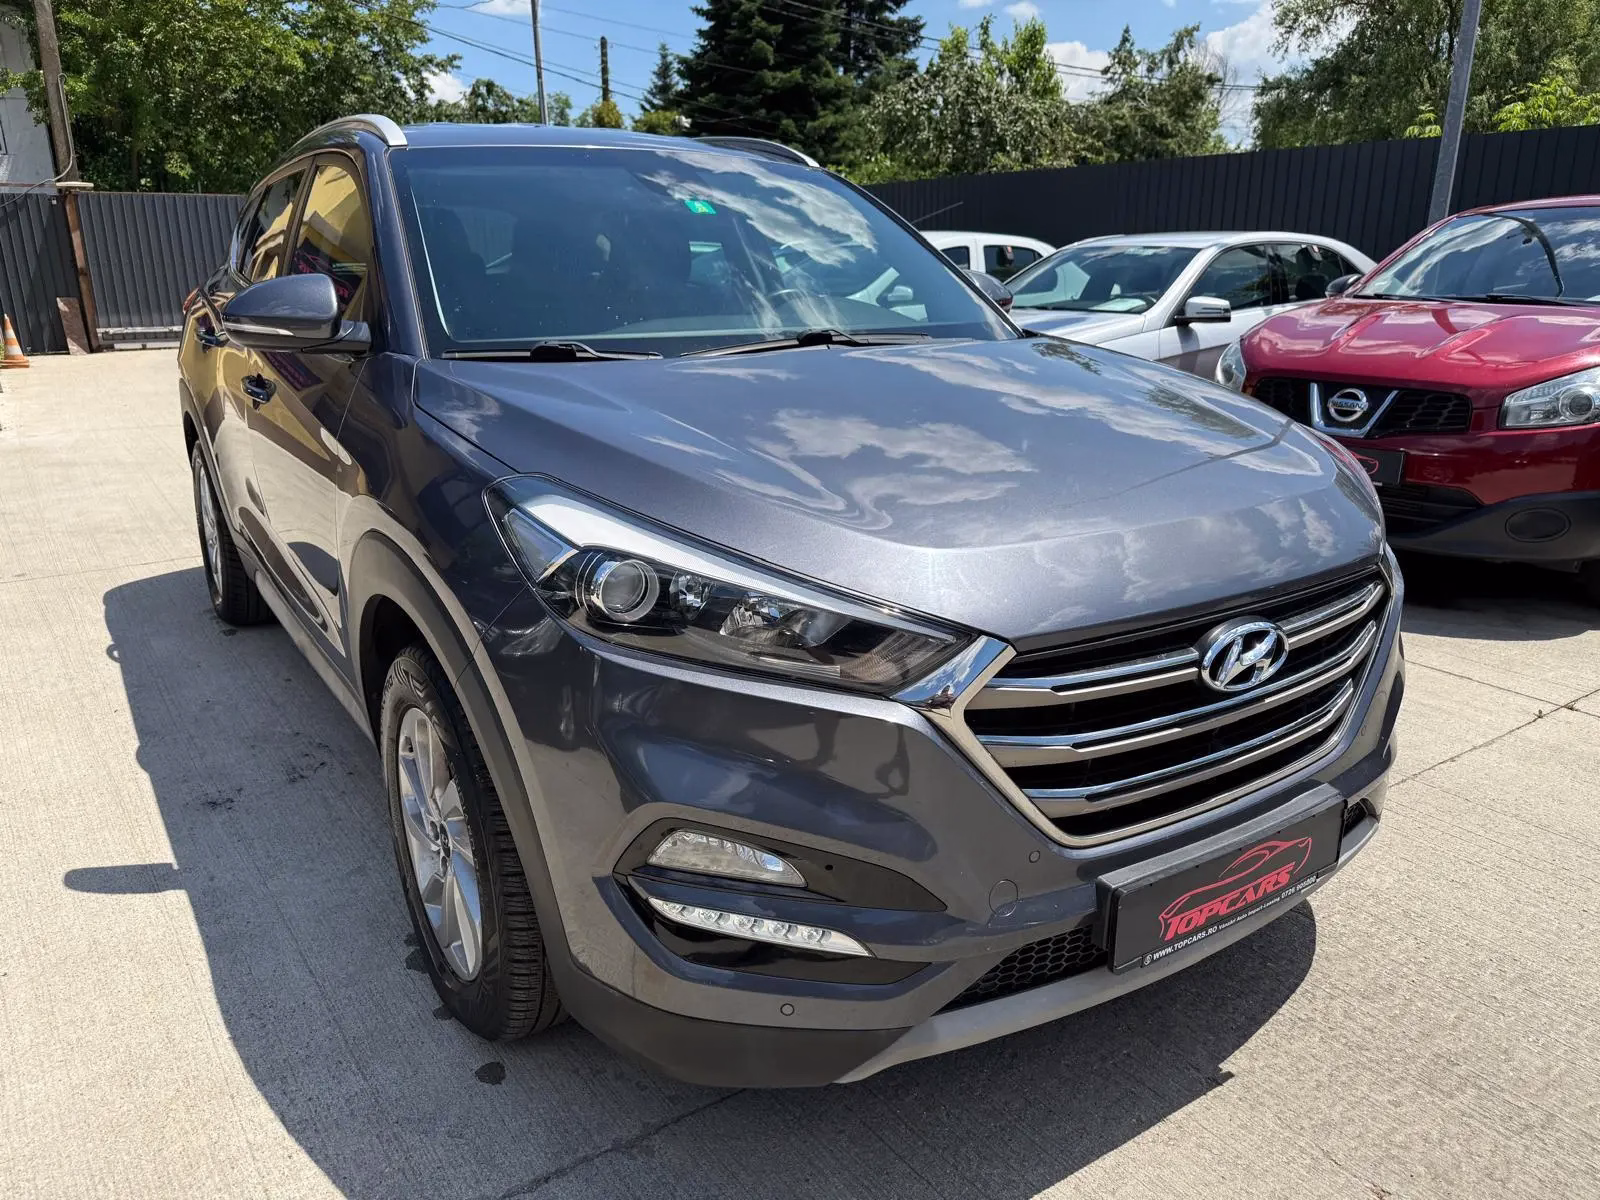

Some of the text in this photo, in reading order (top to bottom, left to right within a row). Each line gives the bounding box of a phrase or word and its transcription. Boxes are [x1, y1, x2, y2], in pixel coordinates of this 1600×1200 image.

[1328, 399, 1366, 410] NISSAN
[1163, 862, 1296, 941] TOPCARS
[1153, 925, 1218, 960] WWW.TOPCARS.RO
